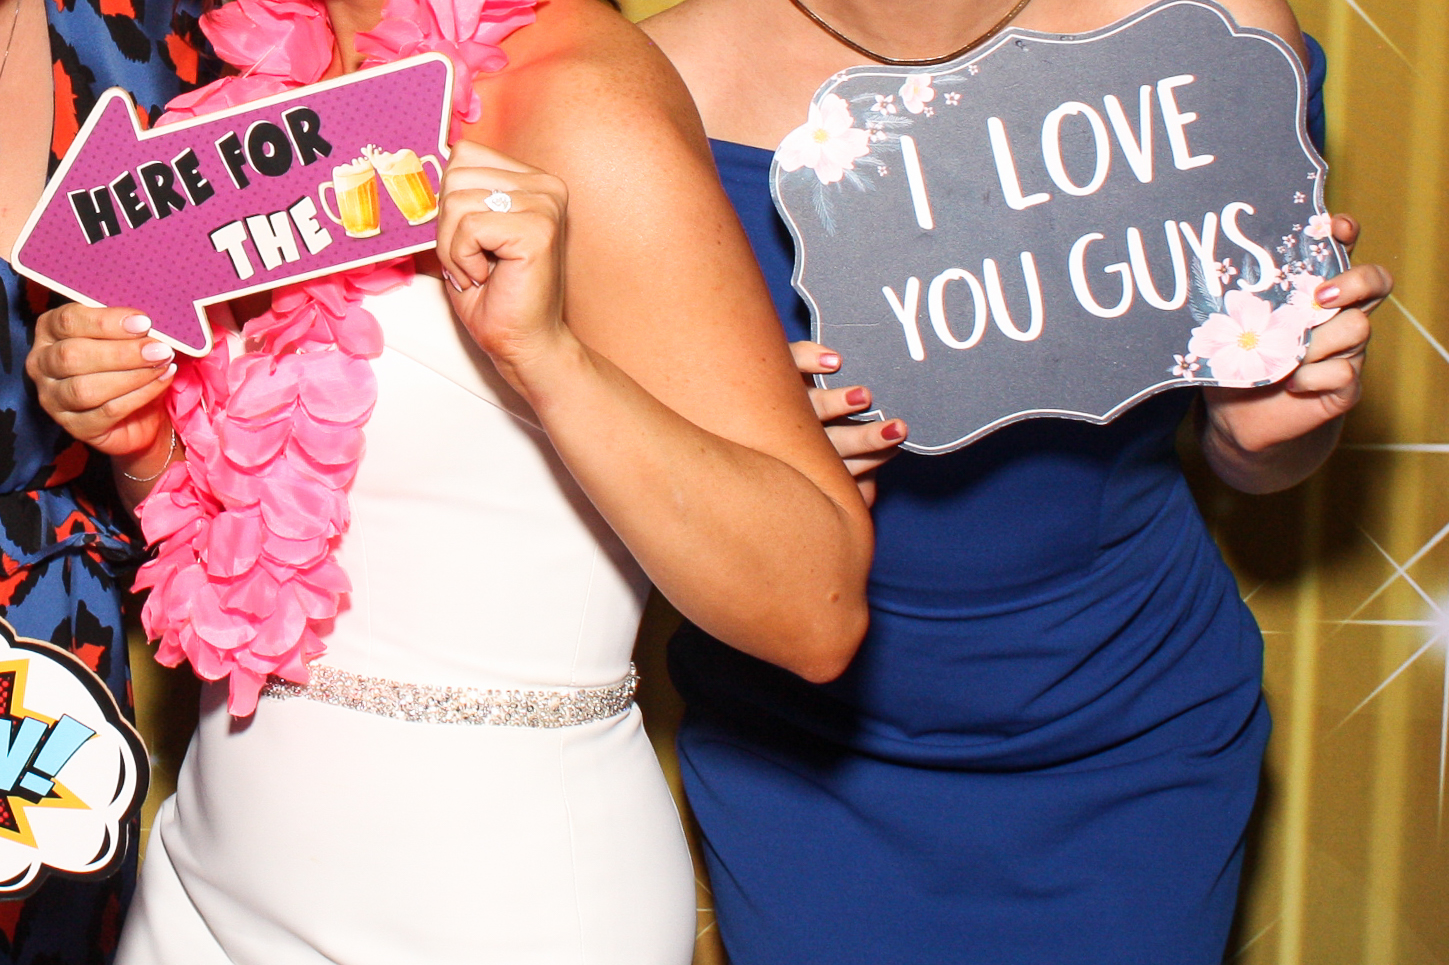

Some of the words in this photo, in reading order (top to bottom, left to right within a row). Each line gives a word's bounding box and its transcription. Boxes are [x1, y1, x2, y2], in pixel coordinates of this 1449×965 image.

[67, 147, 216, 245] HERE
[215, 105, 333, 190] FOR
[899, 135, 934, 230] I
[986, 74, 1215, 210] LOVE
[208, 195, 334, 281] THE
[883, 251, 1045, 361] YOU
[1068, 201, 1277, 318] GUYS
